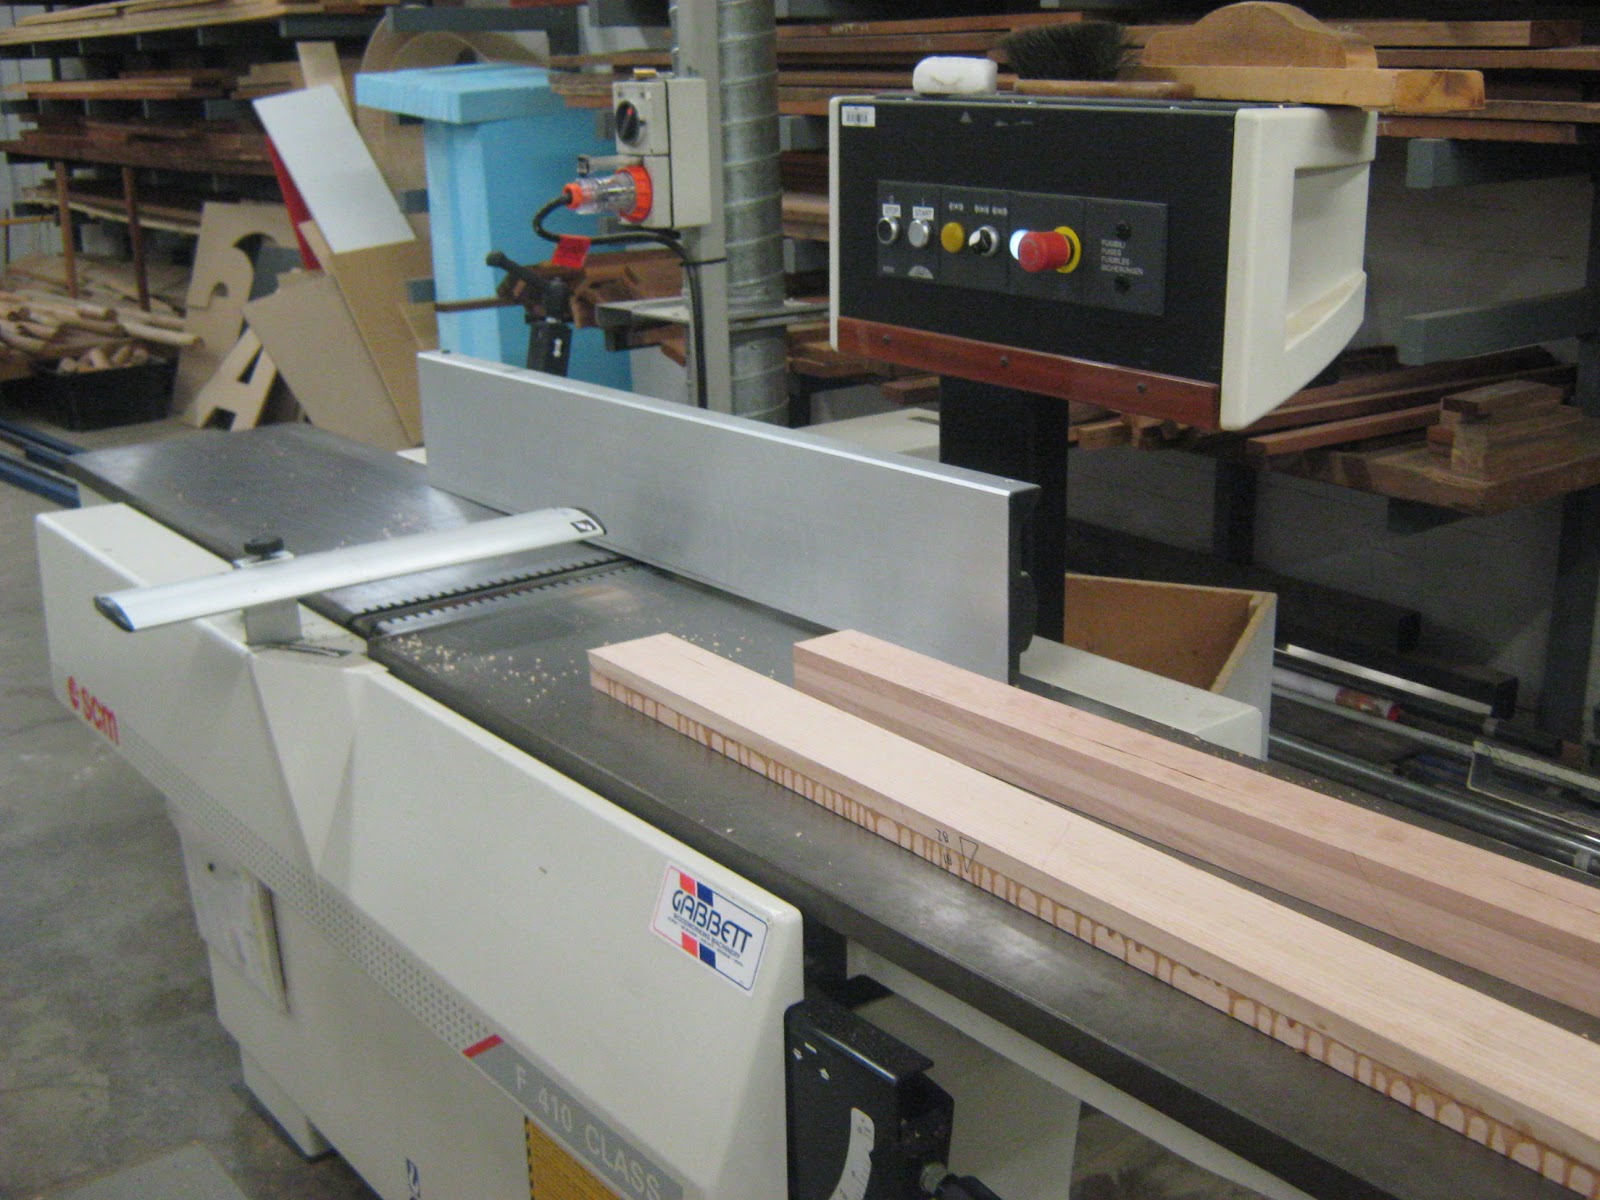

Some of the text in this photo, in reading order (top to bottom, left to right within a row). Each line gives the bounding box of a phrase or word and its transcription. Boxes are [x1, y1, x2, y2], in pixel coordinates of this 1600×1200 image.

[672, 889, 753, 953] GABBETT
[516, 1065, 660, 1200] F 410 CLASS
